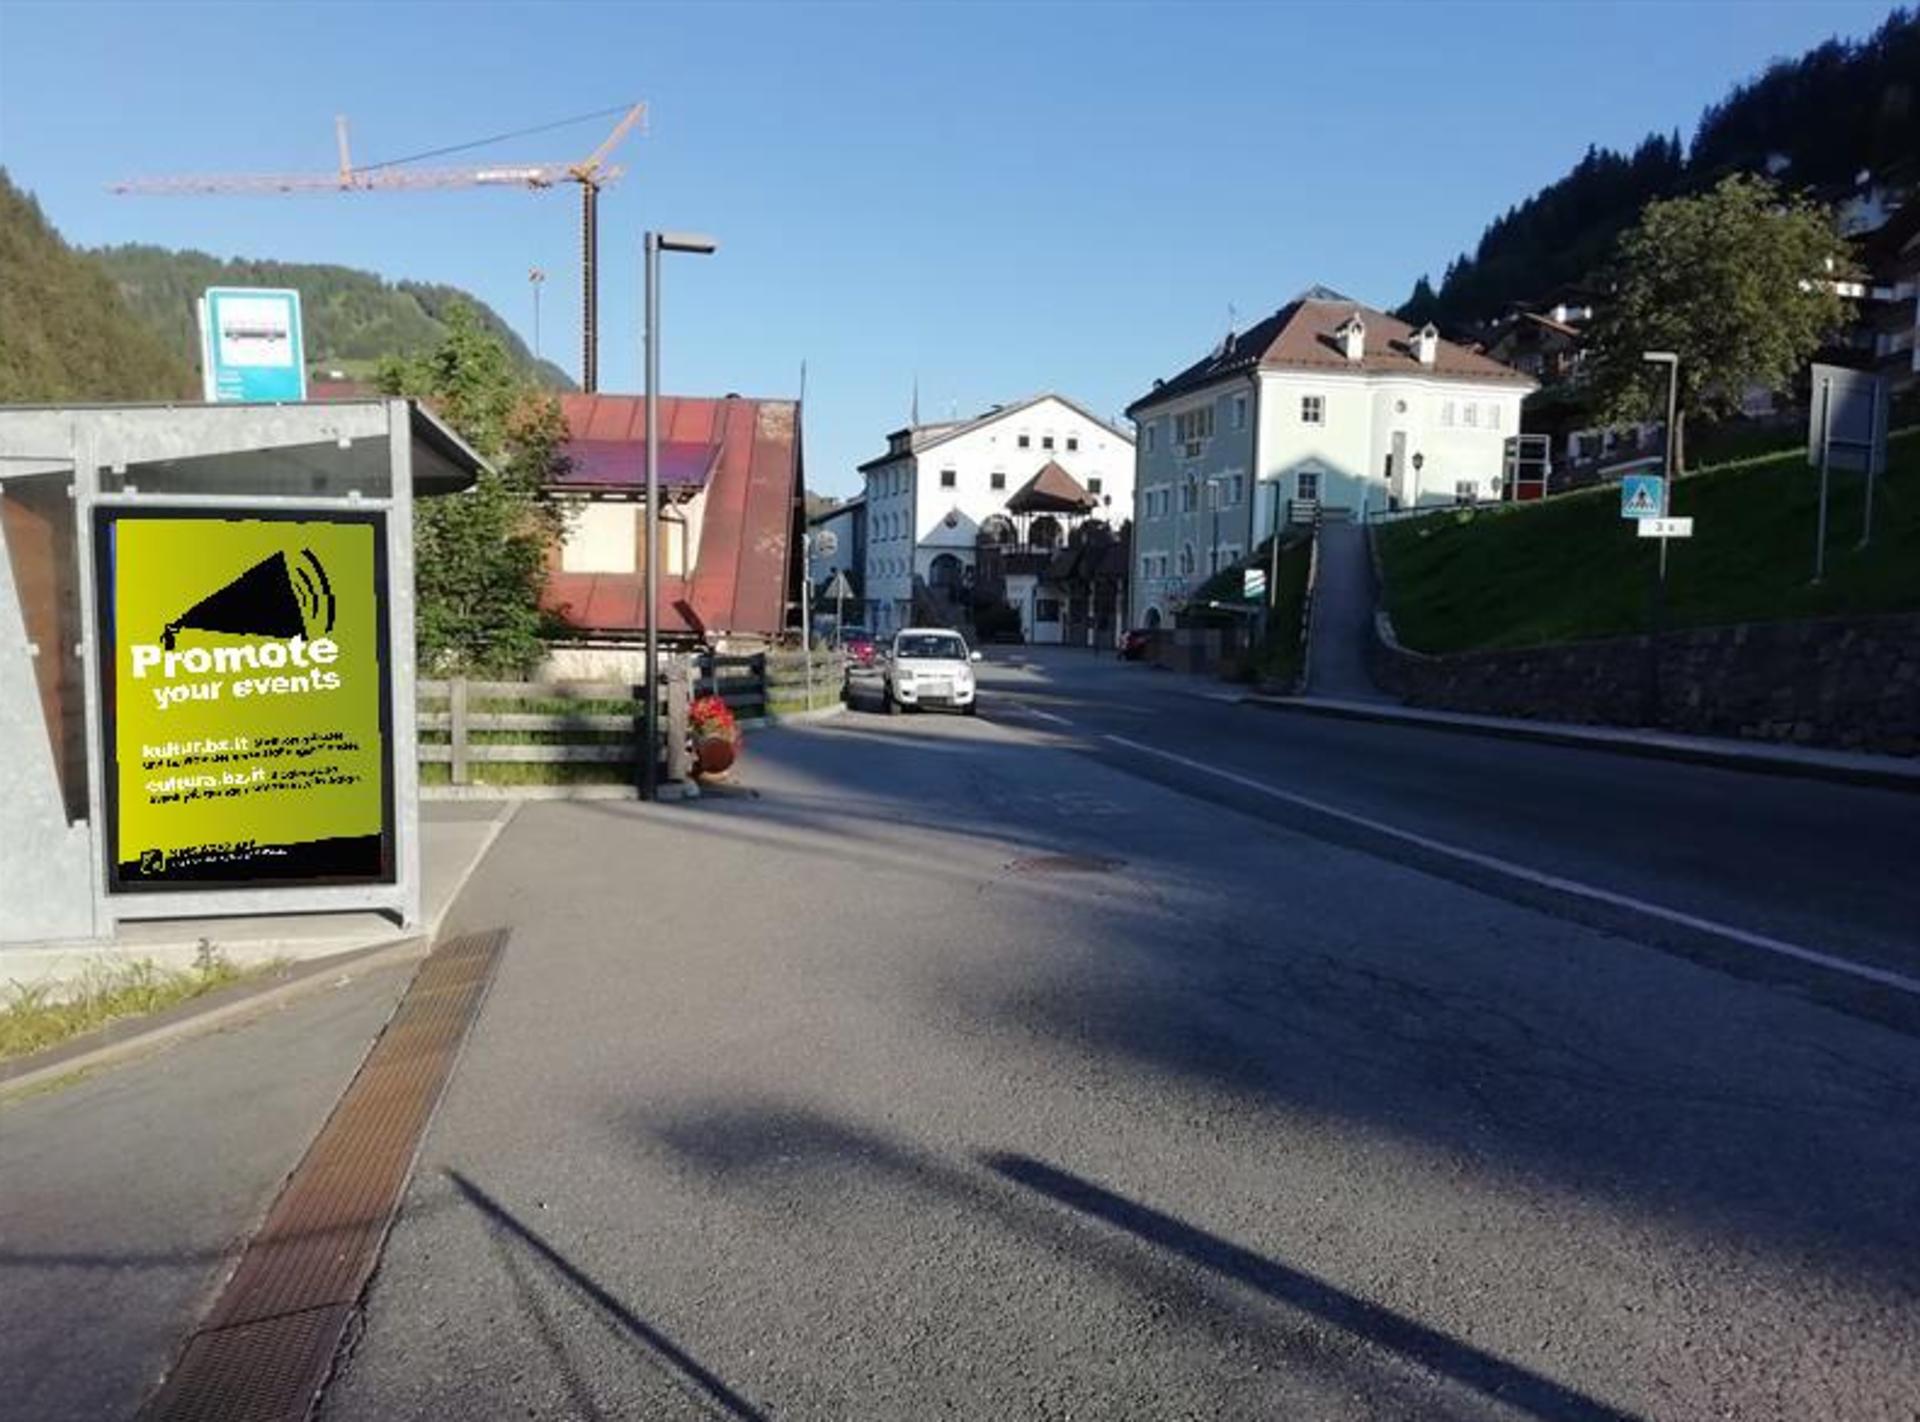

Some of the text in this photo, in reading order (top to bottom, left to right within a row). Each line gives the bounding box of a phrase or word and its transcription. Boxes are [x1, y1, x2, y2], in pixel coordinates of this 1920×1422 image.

[130, 634, 339, 678] Promote
[153, 667, 341, 710] your events
[142, 736, 249, 758] kultur.bz.it
[145, 766, 266, 793] cultura.bz.it
